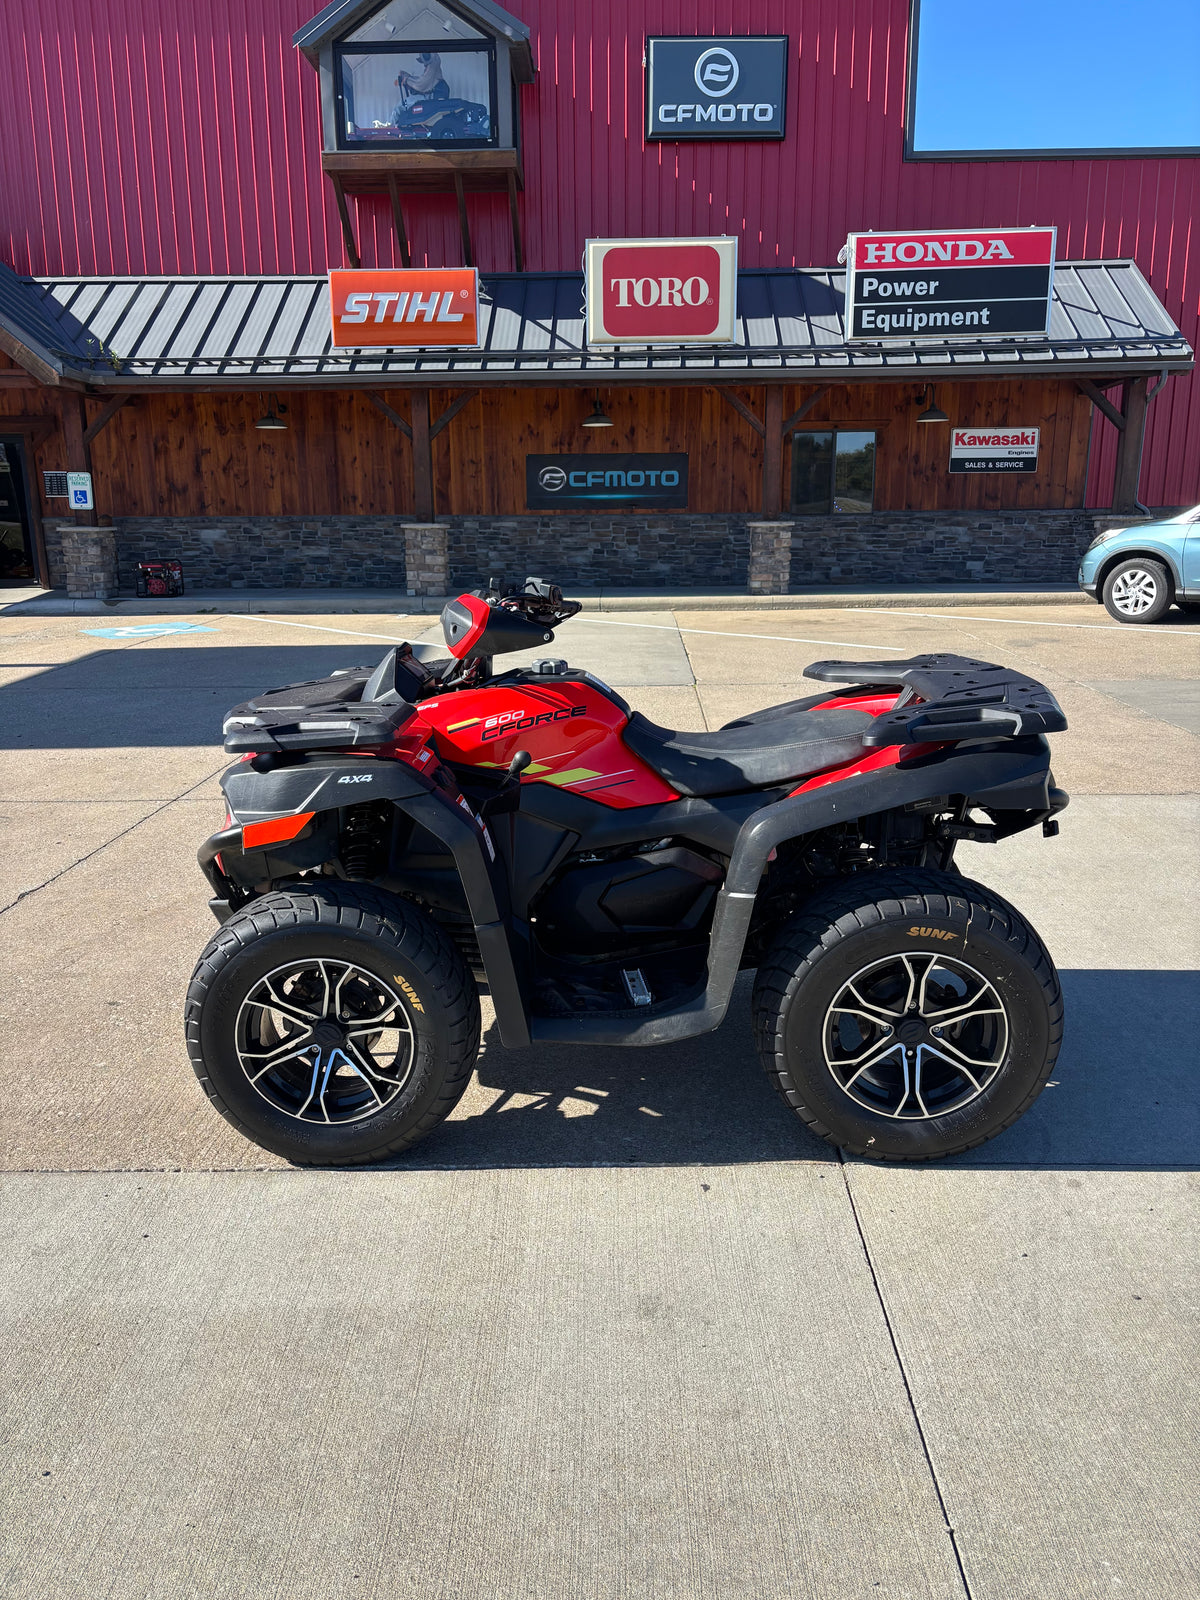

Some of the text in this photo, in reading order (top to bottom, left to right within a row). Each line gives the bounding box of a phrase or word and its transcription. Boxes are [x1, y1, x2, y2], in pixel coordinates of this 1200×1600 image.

[658, 103, 774, 123] CFMOTO
[864, 240, 1014, 263] HONDA
[610, 276, 710, 307] TORO
[862, 277, 939, 297] Power
[340, 291, 465, 324] STIHL
[861, 307, 990, 332] Equipment
[954, 432, 1036, 446] Kawasaki
[568, 470, 680, 487] CFMOTO
[417, 702, 439, 711] EPS
[481, 705, 587, 741] CFORCE
[484, 710, 525, 728] 600
[337, 774, 373, 784] 4X4
[906, 926, 960, 941] SUNF
[393, 975, 425, 1014] SUNF
